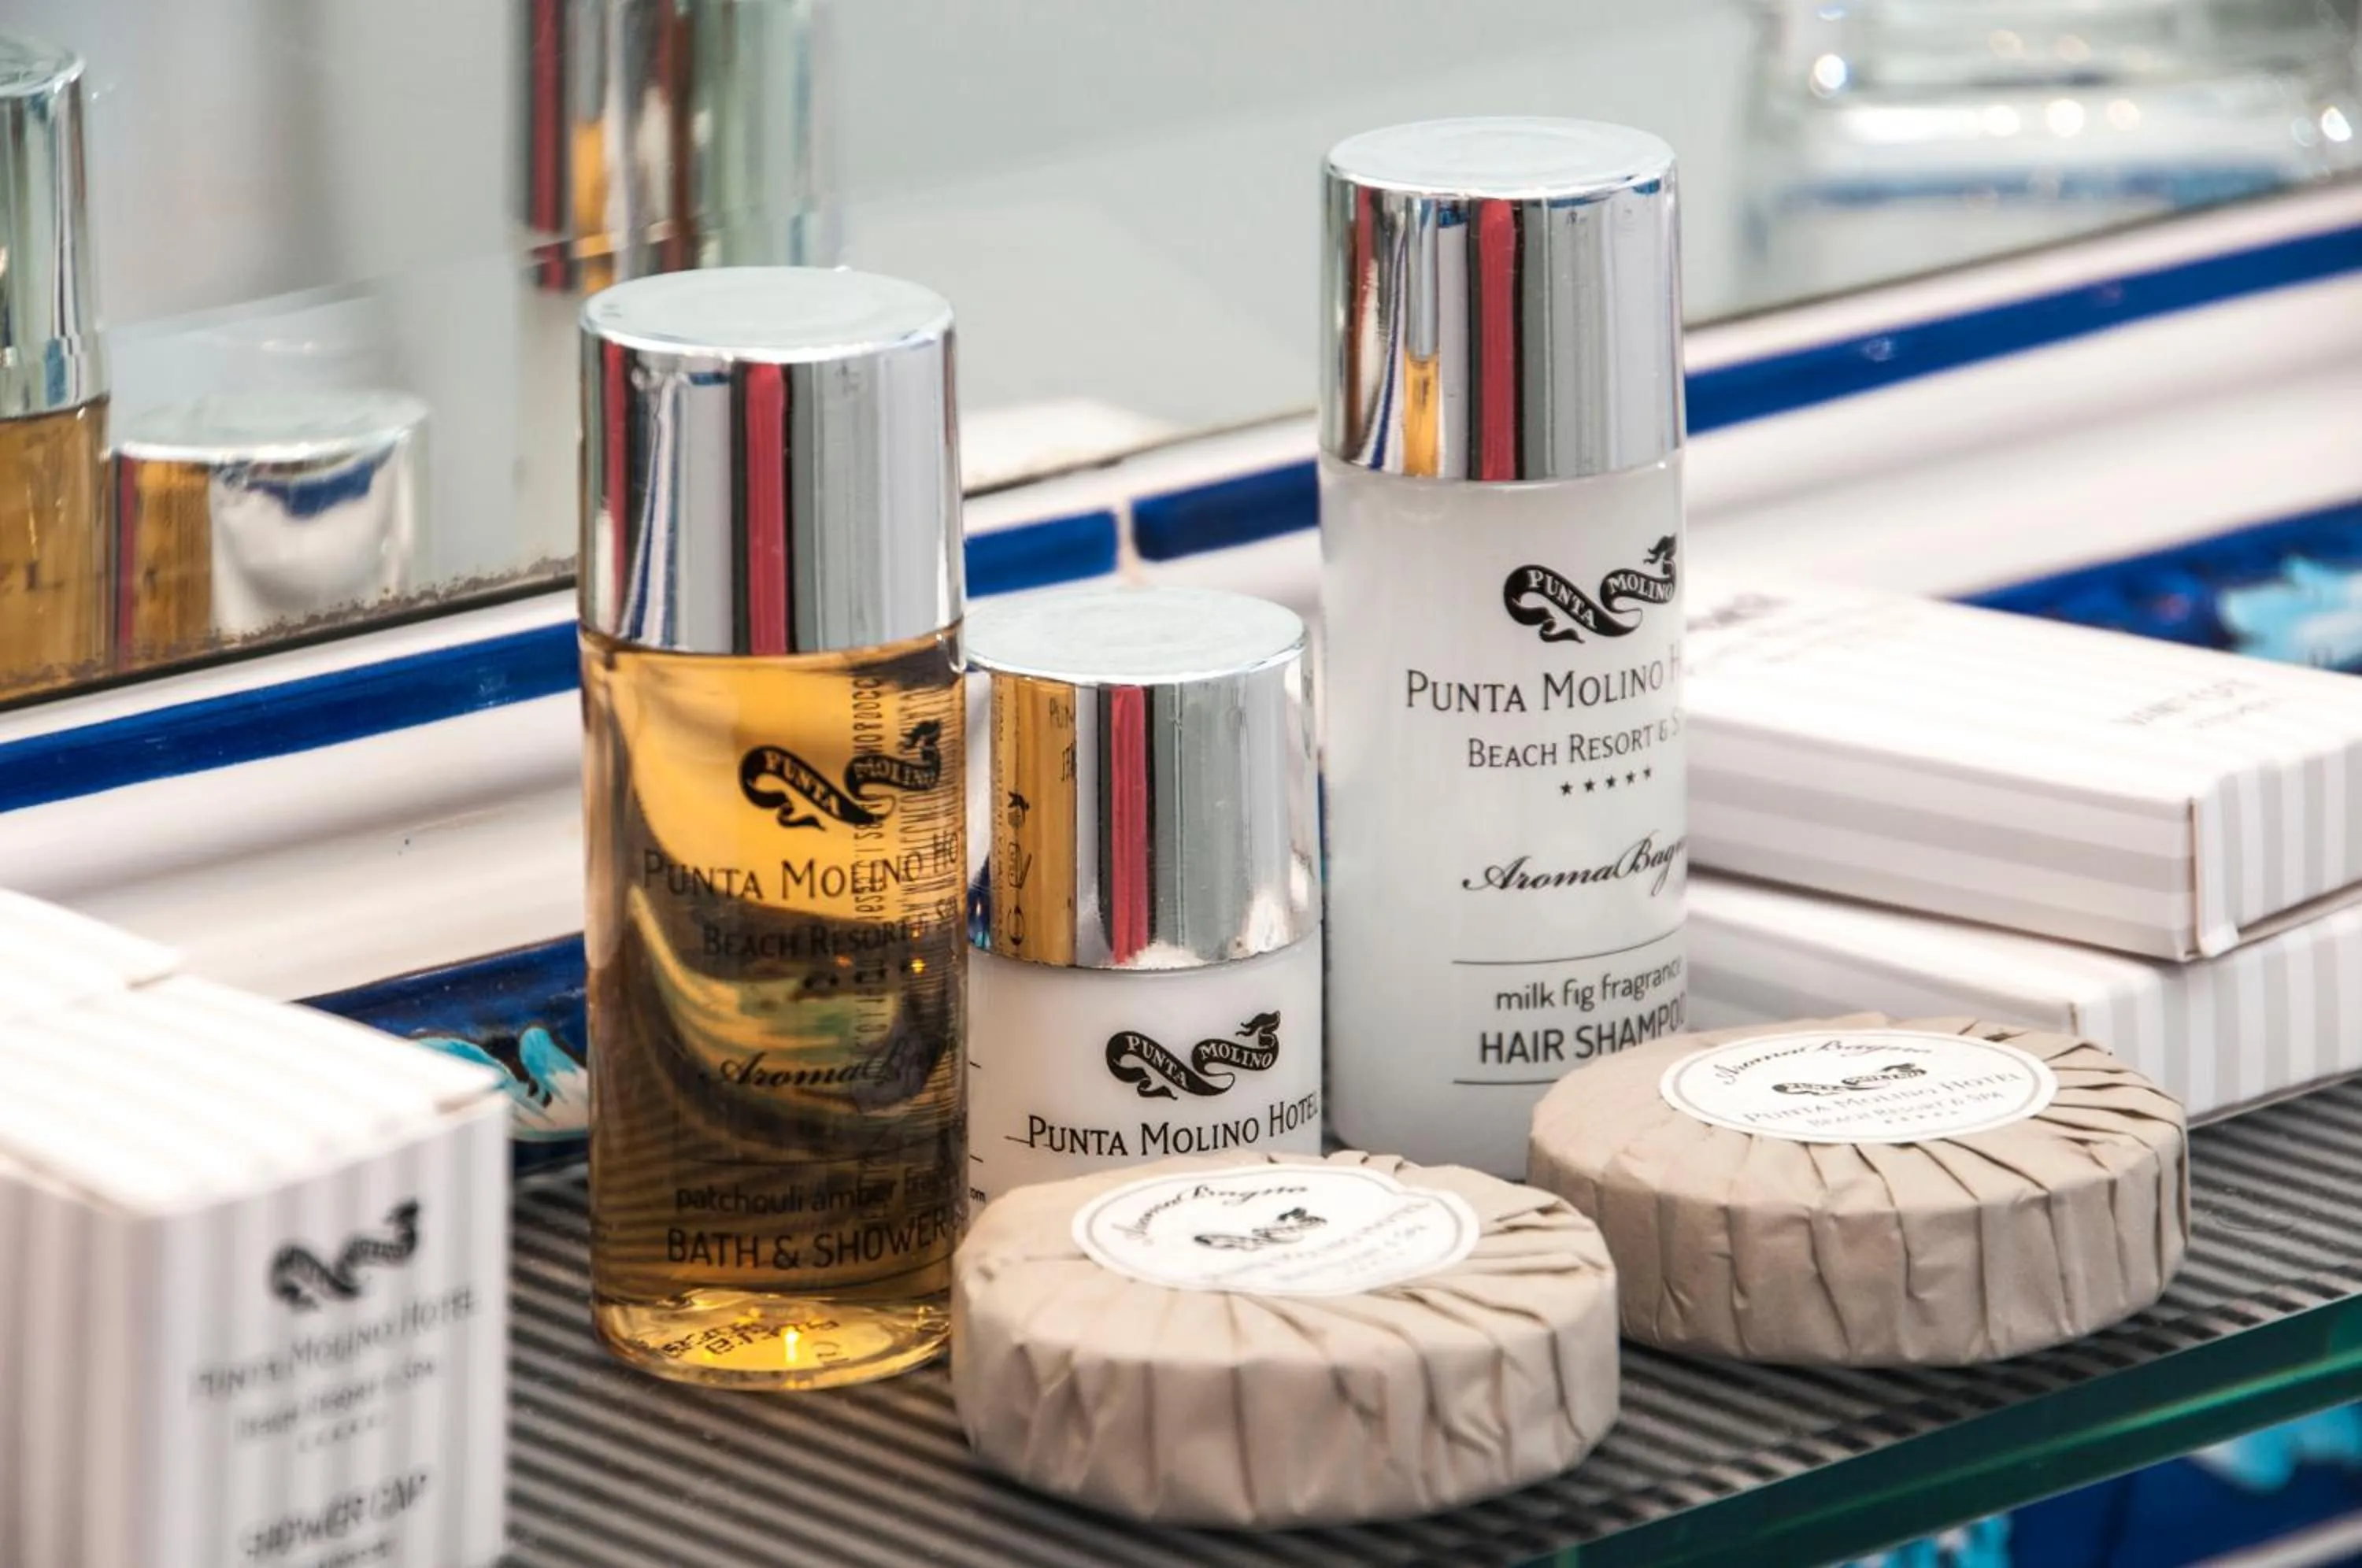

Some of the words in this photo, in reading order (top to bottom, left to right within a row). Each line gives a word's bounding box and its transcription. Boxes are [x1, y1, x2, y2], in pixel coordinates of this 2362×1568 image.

[1527, 569, 1597, 629] PUNTA
[1608, 575, 1674, 601] MOLINO
[1406, 668, 1527, 713] PUNTA
[1542, 660, 1664, 712] MOLINO
[1468, 737, 1558, 768] BEACH
[1568, 723, 1654, 764] RESORT
[764, 752, 842, 815] PUNTA
[643, 848, 763, 900] PUNTA
[781, 852, 924, 900] MOLINO
[702, 925, 798, 957] BEACH
[1496, 982, 1557, 1011] milk
[1563, 979, 1595, 1012] fig
[1127, 1034, 1190, 1090] PUNTA
[1199, 1043, 1273, 1069] MOLINO
[1480, 1028, 1566, 1064] HAIR
[1027, 1115, 1129, 1158] PUNTA
[1140, 1116, 1260, 1157] MOLINO
[676, 1184, 804, 1215] patchouli
[667, 1228, 760, 1269] BATH
[771, 1237, 800, 1271] &
[813, 1207, 946, 1269] SHOWER
